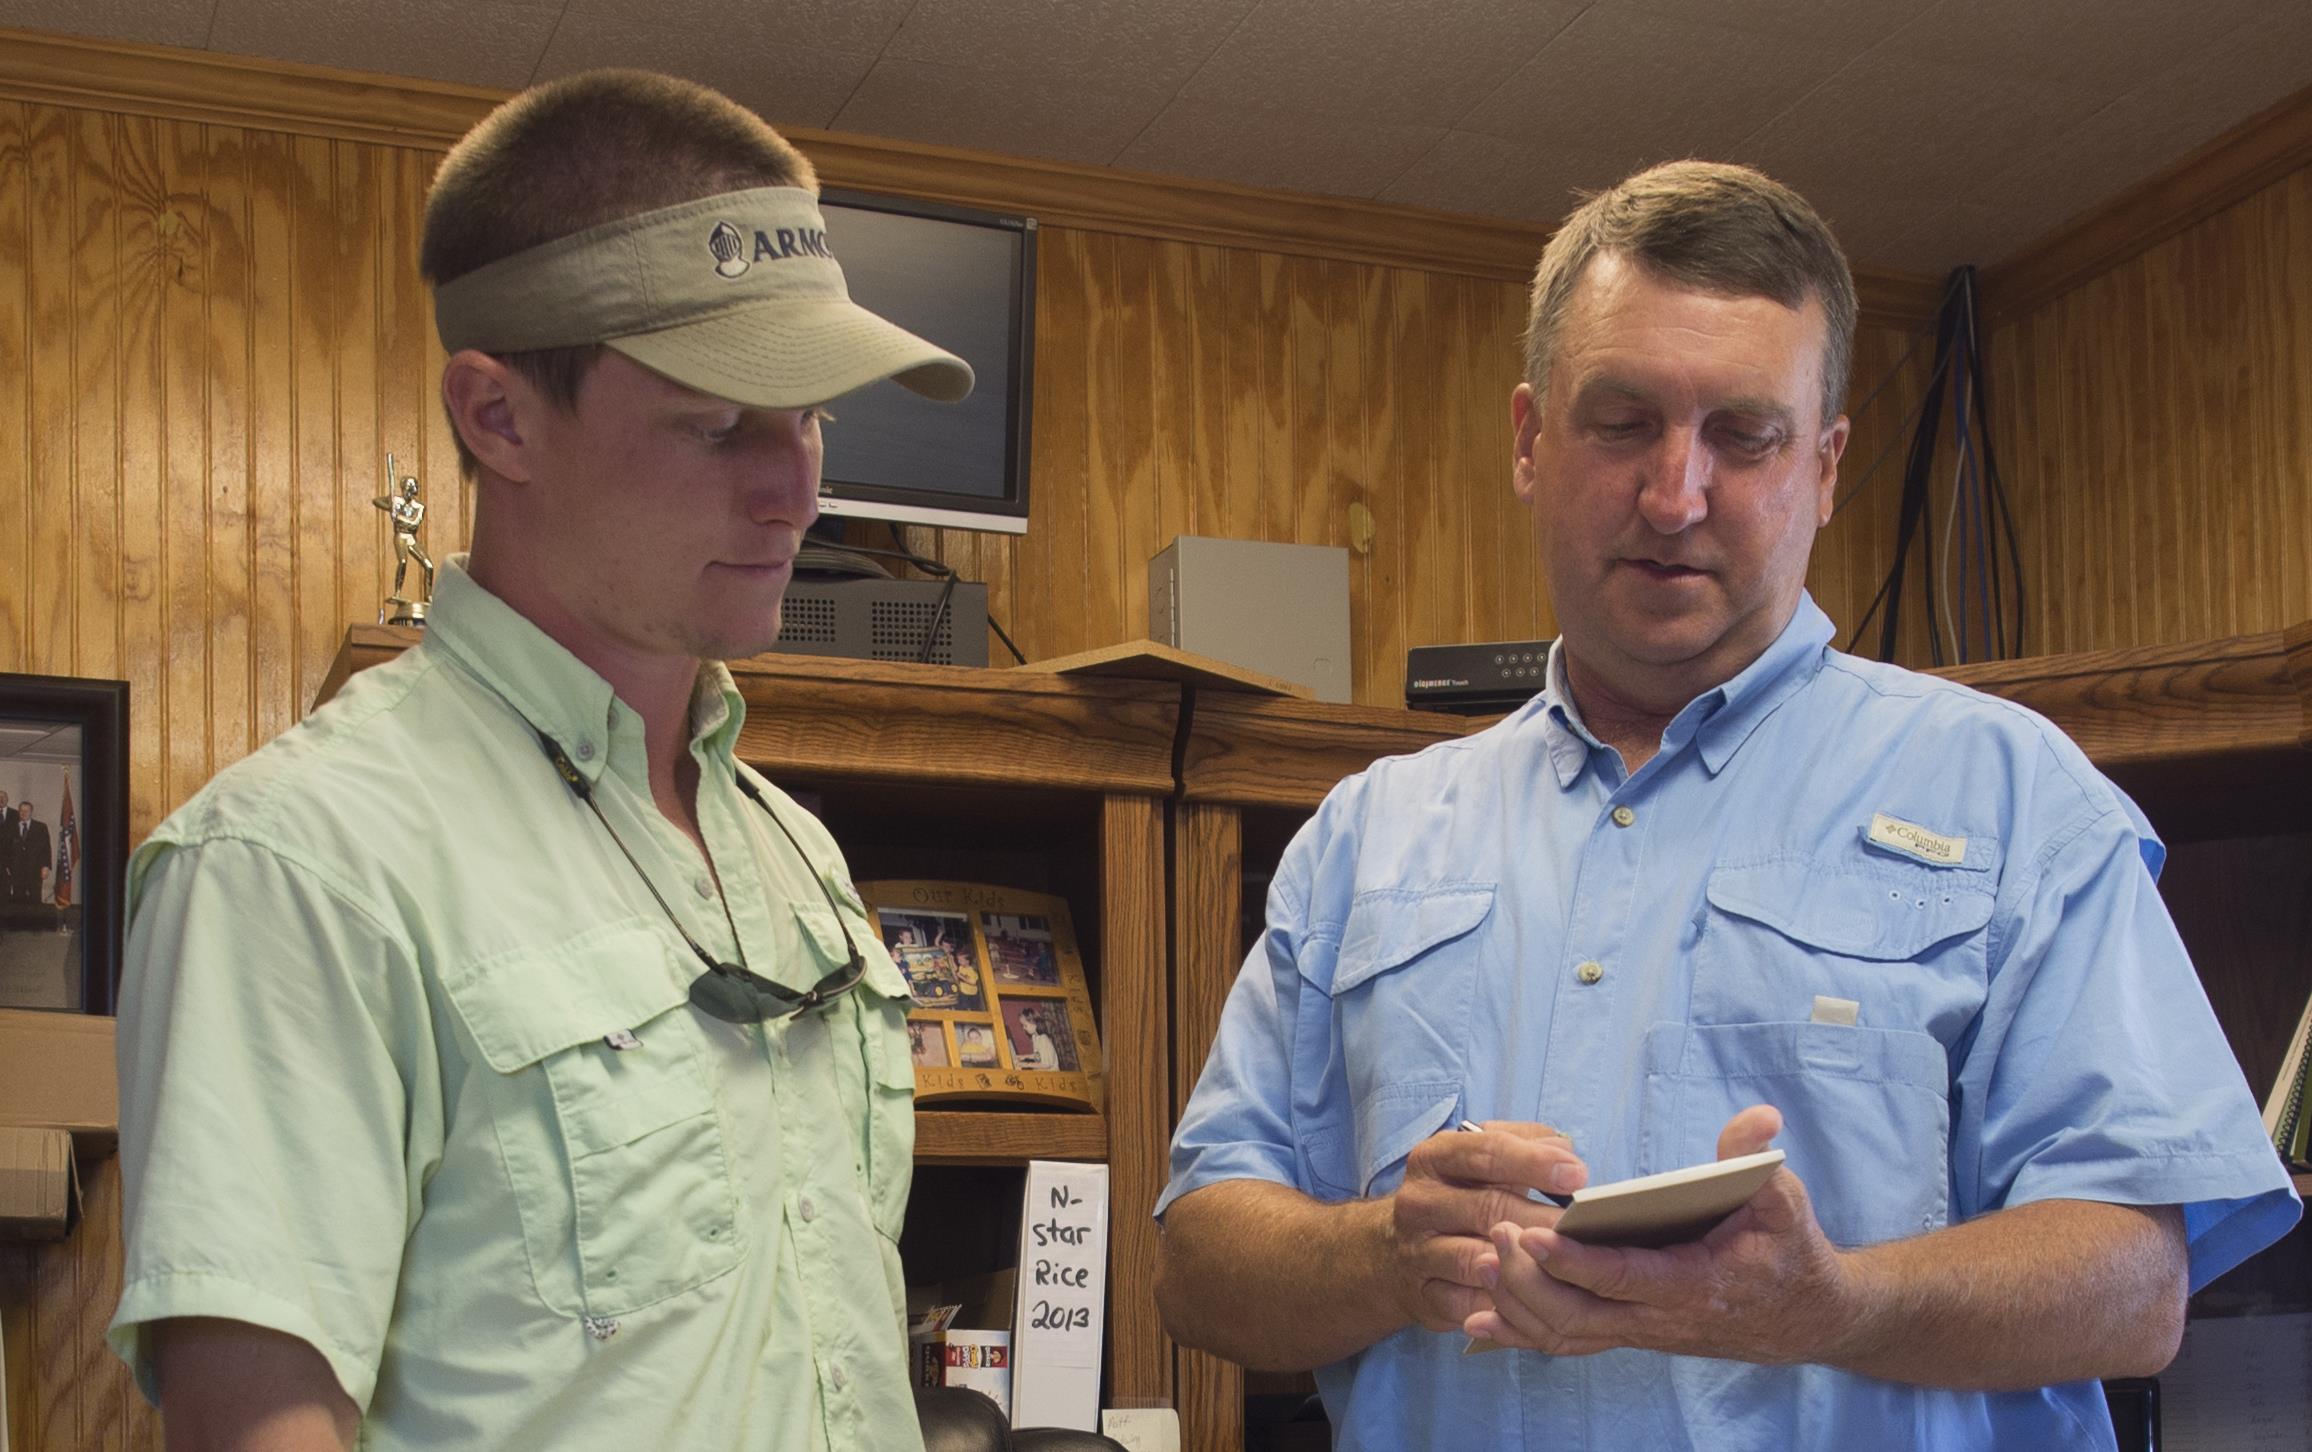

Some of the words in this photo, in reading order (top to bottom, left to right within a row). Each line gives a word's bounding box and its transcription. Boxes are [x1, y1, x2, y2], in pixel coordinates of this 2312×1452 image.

[1896, 826, 1951, 854] Columbia
[922, 1073, 964, 1090] Kids
[1035, 1076, 1078, 1093] Kids
[1035, 1259, 1089, 1289] Rice
[1031, 1300, 1090, 1332] 2013
